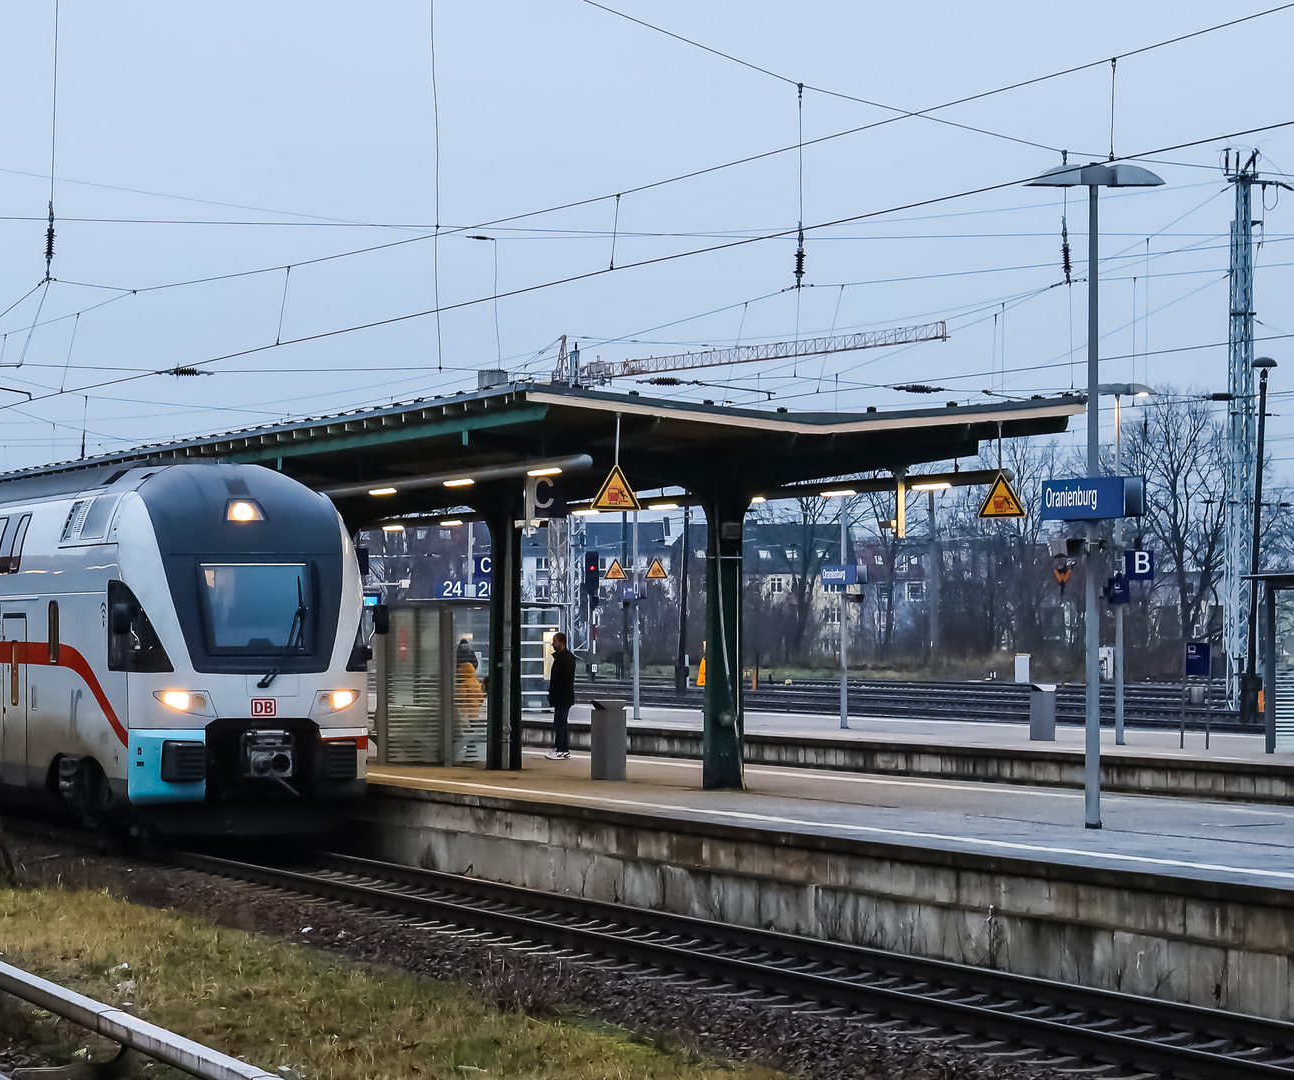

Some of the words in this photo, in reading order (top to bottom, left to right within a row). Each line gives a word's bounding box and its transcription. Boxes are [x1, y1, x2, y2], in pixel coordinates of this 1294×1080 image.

[535, 476, 554, 509] C
[1046, 486, 1098, 511] Oranienburg
[480, 557, 491, 573] C
[1135, 551, 1151, 574] B
[442, 580, 463, 597] 24
[478, 581, 491, 597] 2
[253, 701, 274, 714] DB
